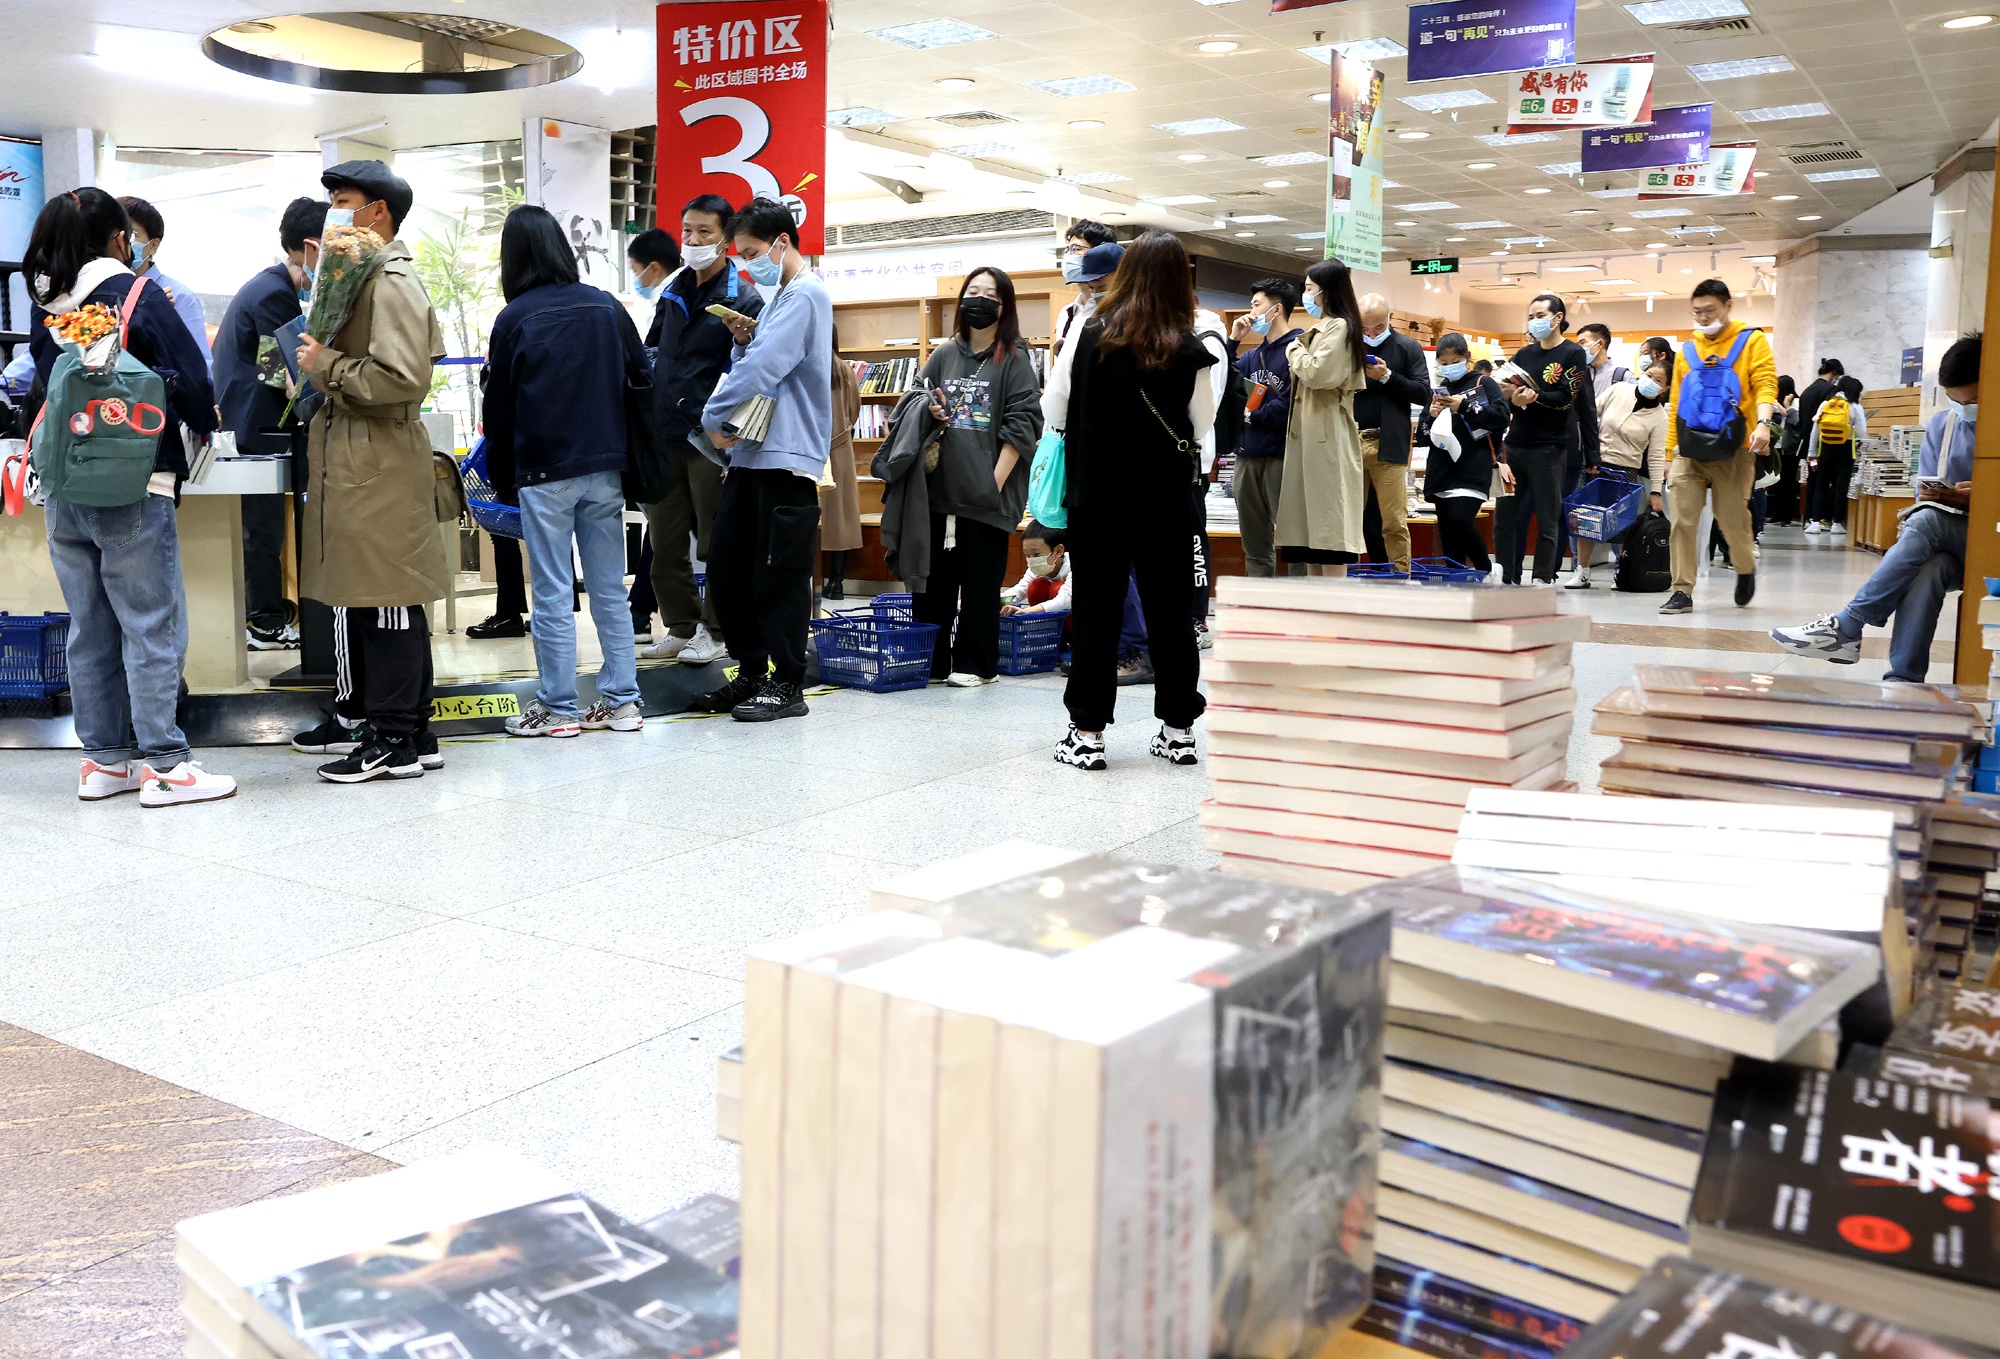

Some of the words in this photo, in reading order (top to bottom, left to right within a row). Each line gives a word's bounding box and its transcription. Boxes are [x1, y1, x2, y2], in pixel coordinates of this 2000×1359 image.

[672, 14, 803, 66] 特价区
[694, 60, 808, 90] 此区域图书全场
[1519, 70, 1588, 95] 感恩有你
[1530, 100, 1540, 112] 6
[1561, 101, 1571, 113] 5
[679, 96, 783, 201] 3
[1656, 174, 1664, 184] 6
[1681, 175, 1689, 186] 5
[436, 697, 517, 718] 小心台阶
